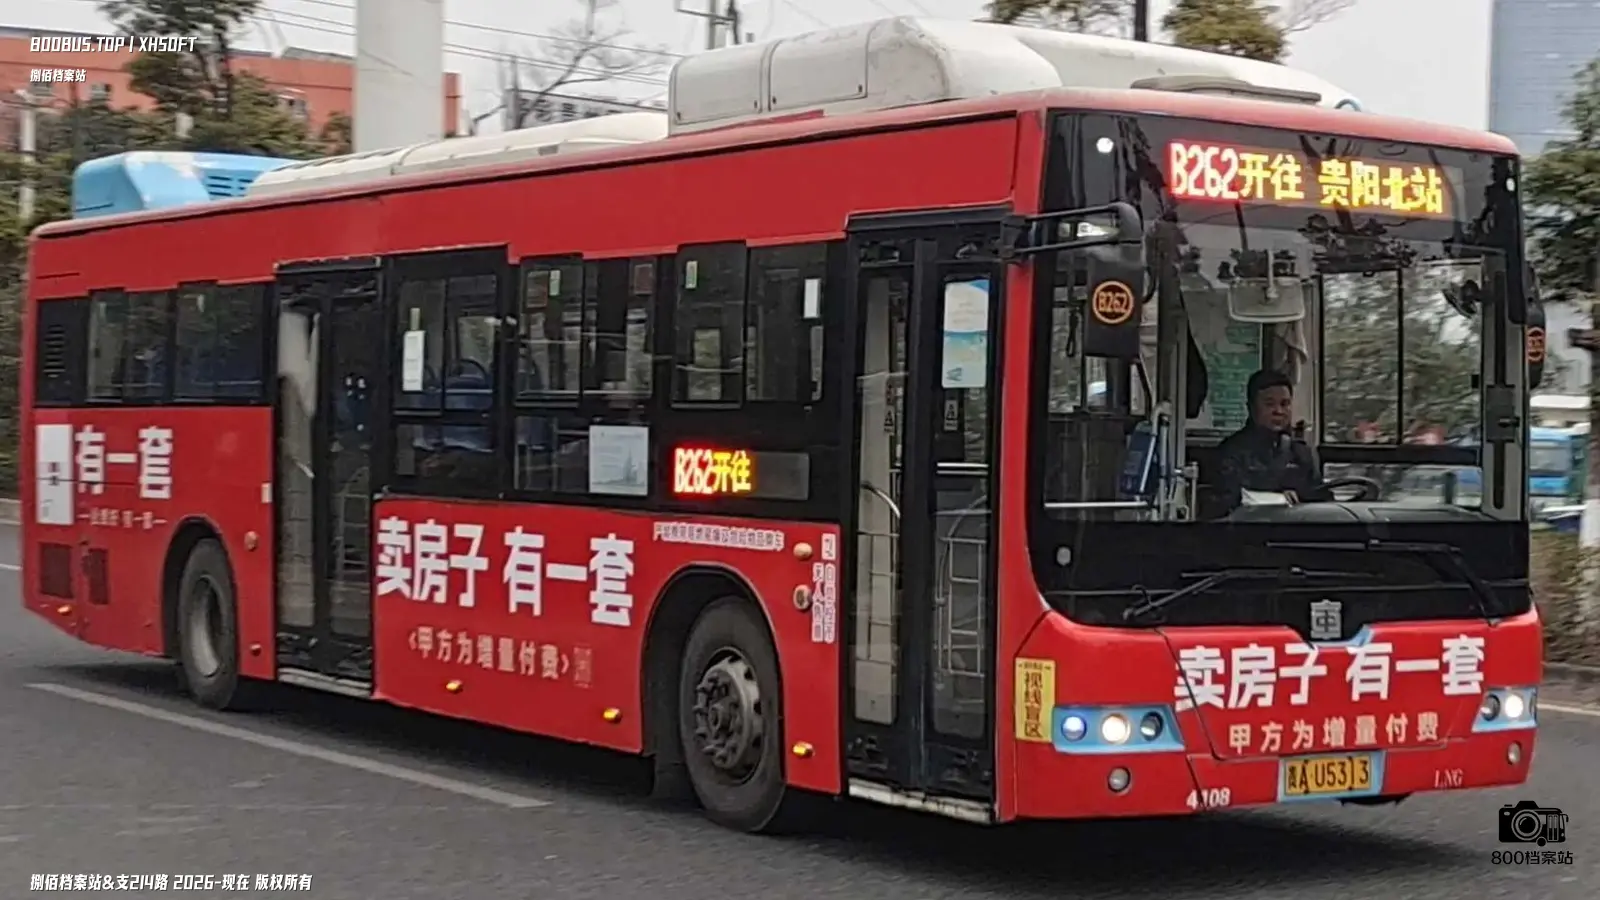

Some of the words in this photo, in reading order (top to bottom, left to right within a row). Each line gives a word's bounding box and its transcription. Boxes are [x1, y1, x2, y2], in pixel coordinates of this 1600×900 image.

[1169, 142, 1305, 201] B262开往
[1318, 158, 1444, 214] 贵阳北站
[75, 424, 173, 499] 有一套
[673, 447, 753, 494] B262开往
[376, 516, 489, 608] 卖房子
[503, 525, 635, 627] 有一套
[1173, 642, 1328, 713] 卖房子
[1346, 634, 1486, 702] 有一套
[1228, 712, 1440, 755] 甲方为增量付费
[1186, 786, 1231, 810] 4108
